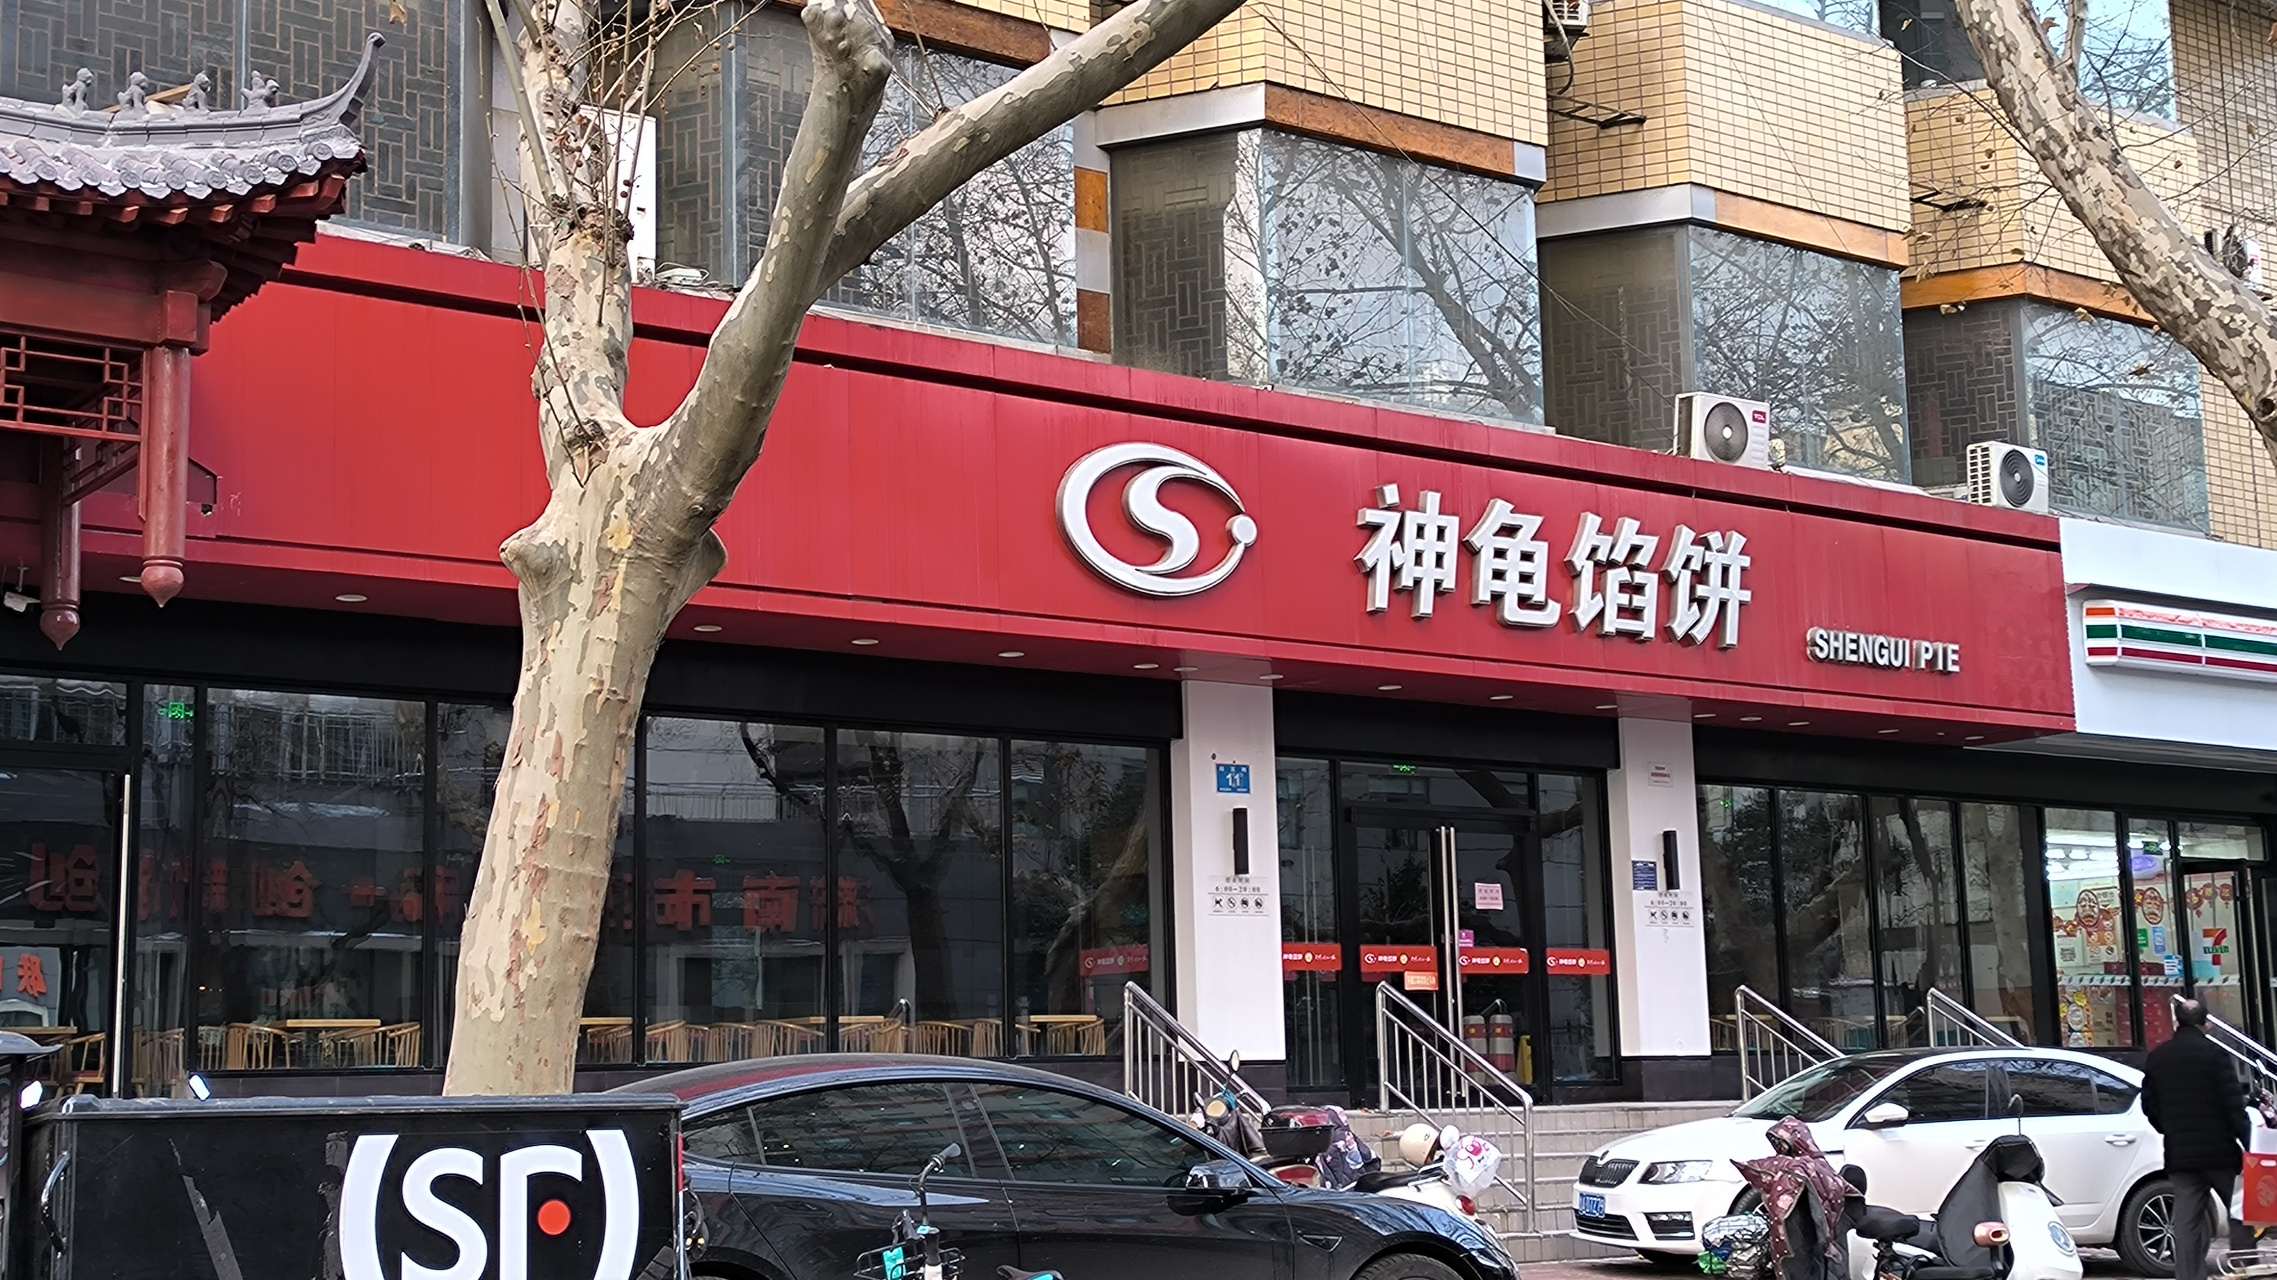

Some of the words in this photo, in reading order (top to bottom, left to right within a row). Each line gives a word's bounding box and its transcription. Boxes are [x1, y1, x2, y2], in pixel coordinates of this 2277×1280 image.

[1353, 482, 1752, 650] 神龟馅饼
[1807, 626, 1911, 670] SHENGUI
[1912, 640, 1961, 673] PIE
[400, 1143, 583, 1280] SF
